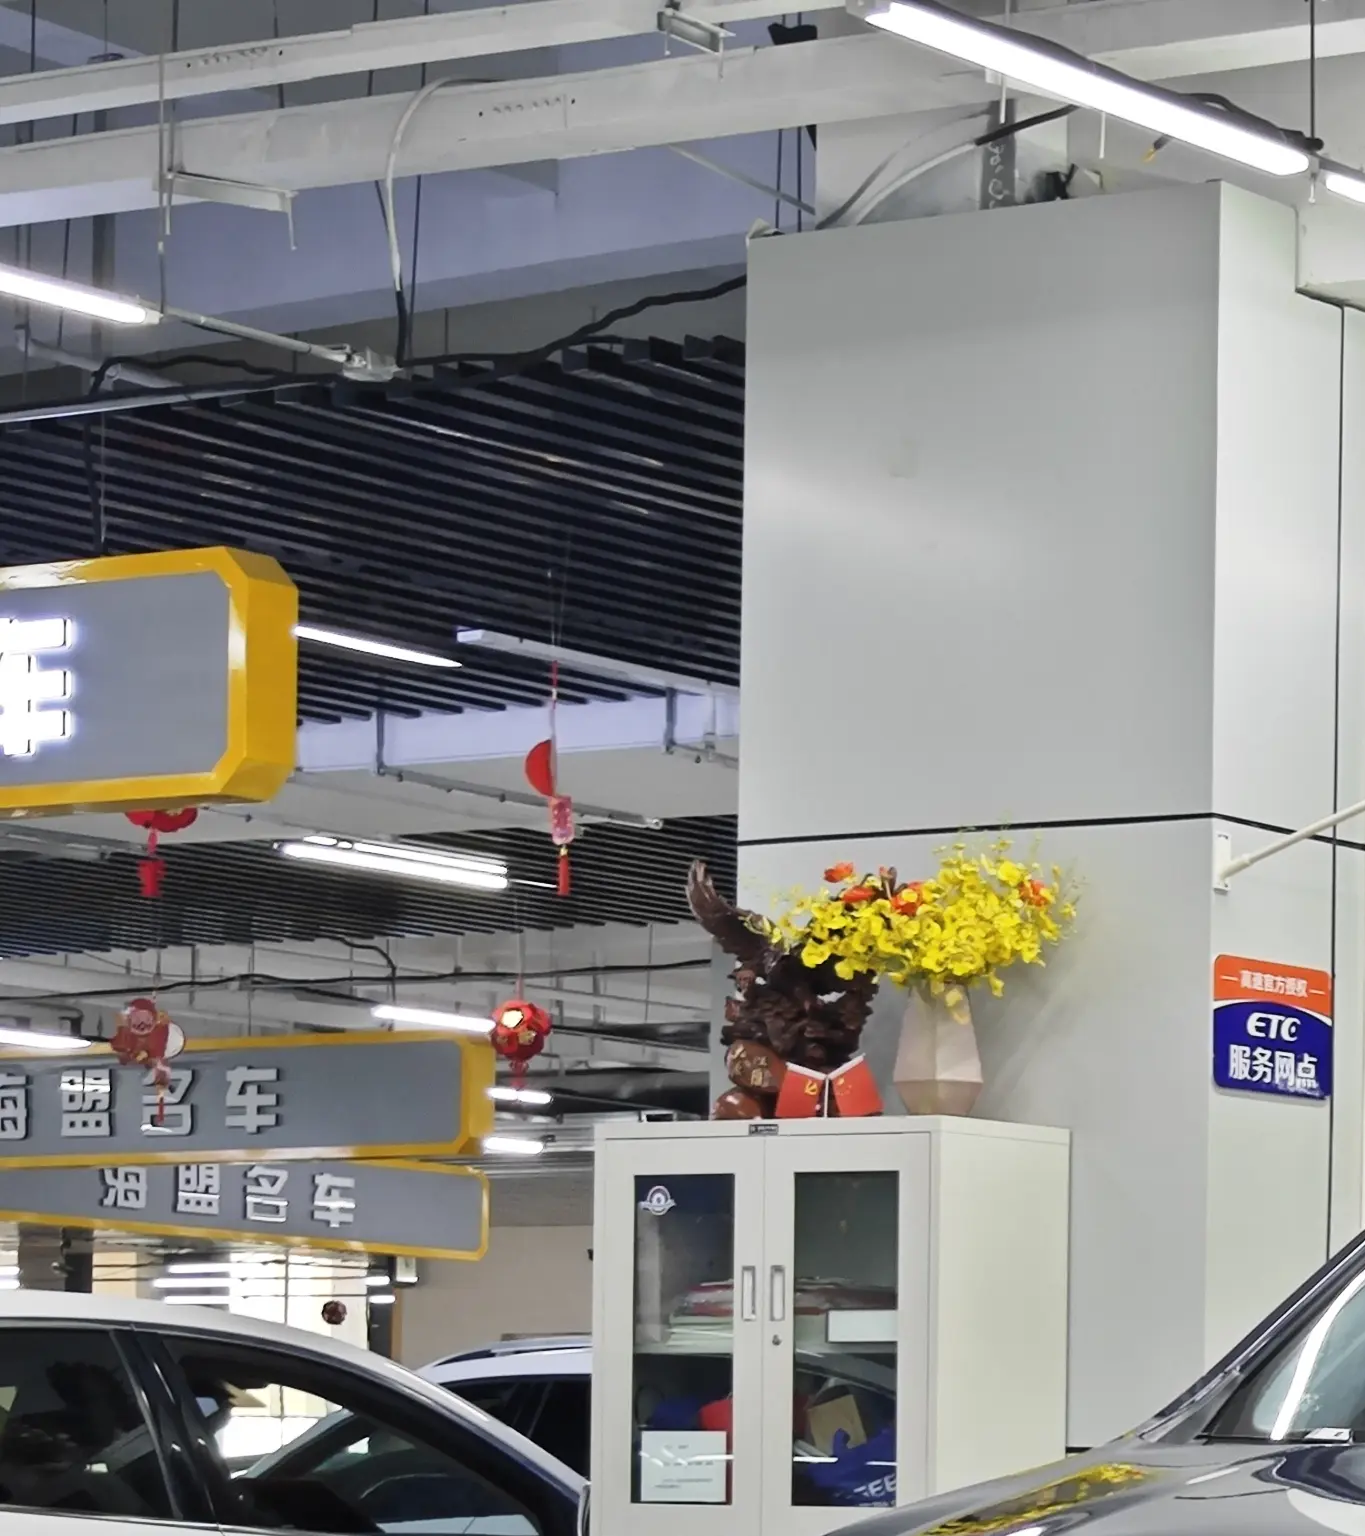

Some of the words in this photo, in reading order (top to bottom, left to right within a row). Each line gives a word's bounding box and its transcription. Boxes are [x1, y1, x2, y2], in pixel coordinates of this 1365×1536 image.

[1246, 1011, 1301, 1041] ETC
[1229, 1044, 1318, 1090] 服务网点
